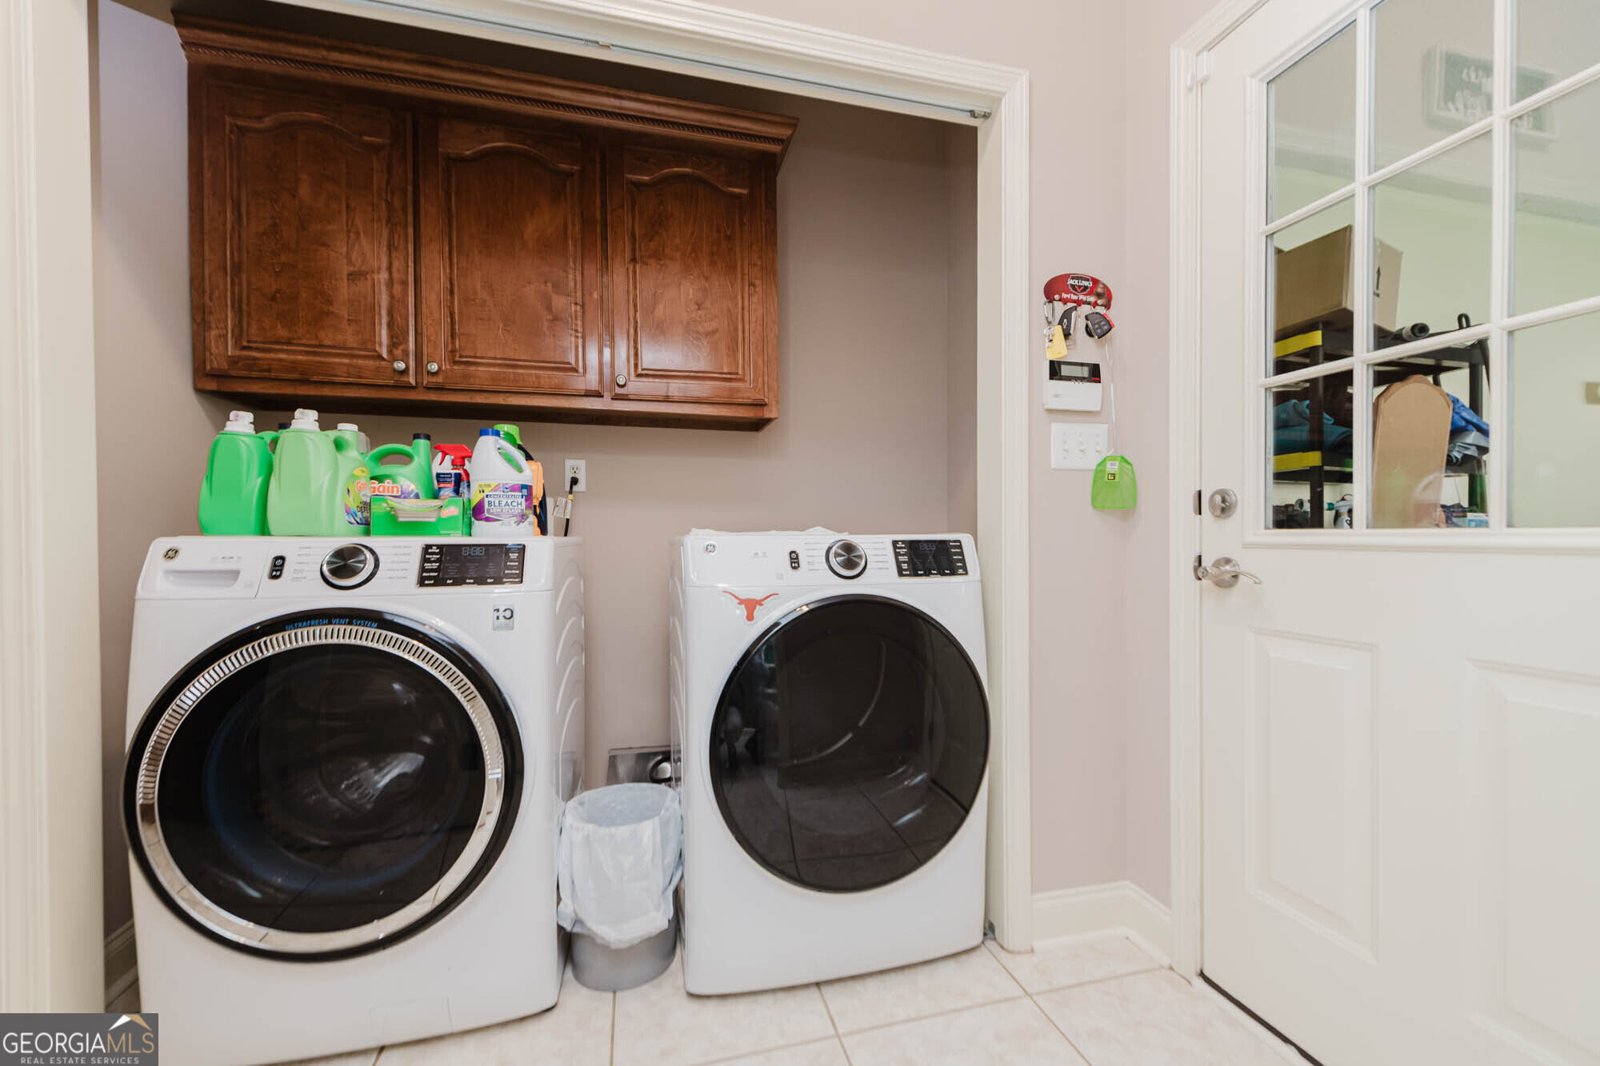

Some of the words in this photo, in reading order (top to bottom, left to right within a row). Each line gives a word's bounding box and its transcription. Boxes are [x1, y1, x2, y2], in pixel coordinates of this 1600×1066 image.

[370, 480, 401, 496] Gain
[285, 618, 329, 631] ULTRAFRESH
[352, 619, 378, 628] SYSTEM
